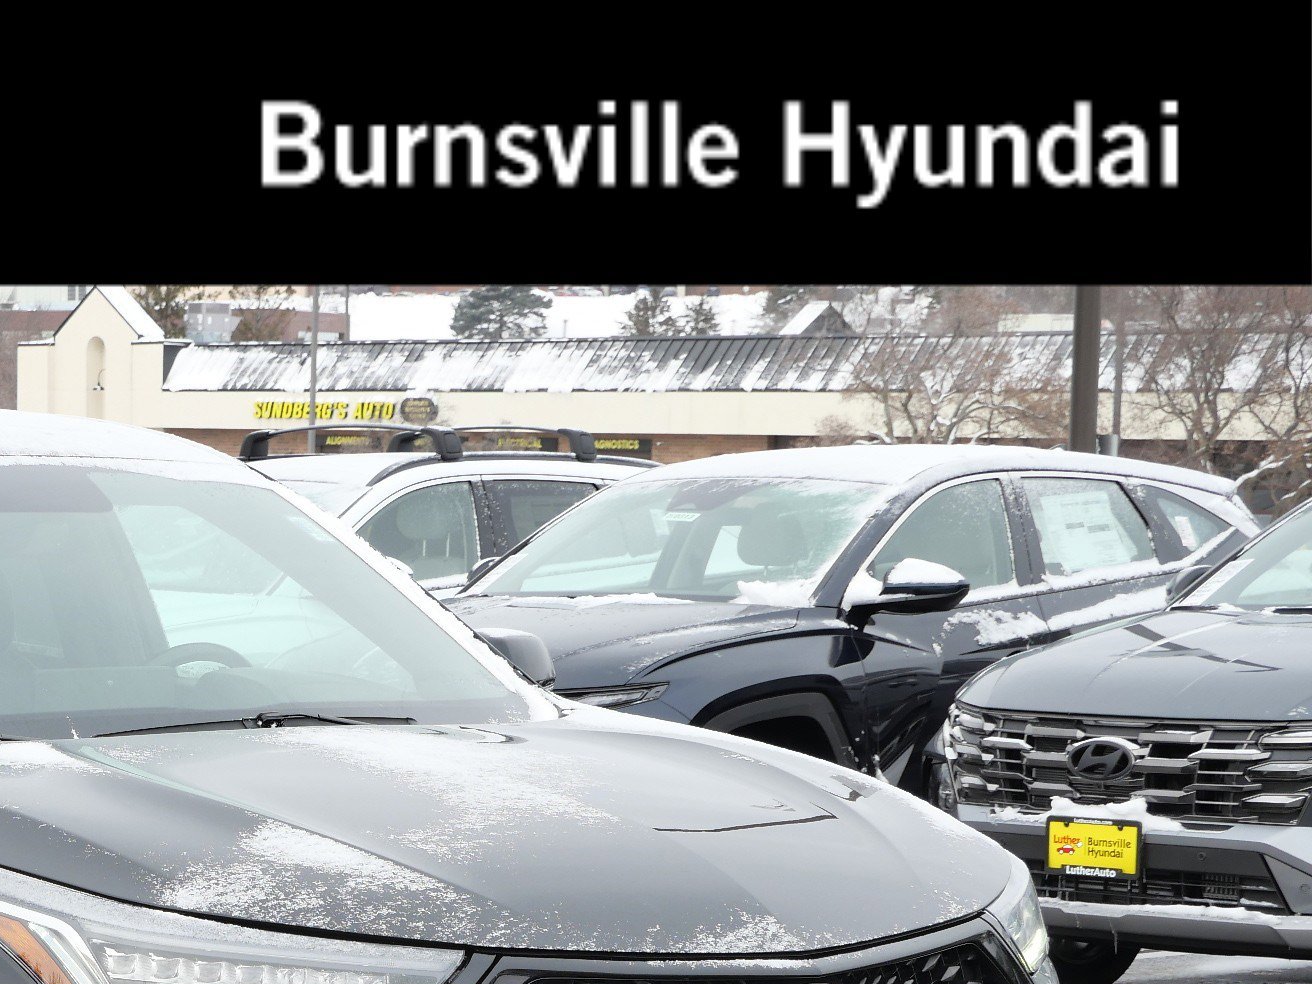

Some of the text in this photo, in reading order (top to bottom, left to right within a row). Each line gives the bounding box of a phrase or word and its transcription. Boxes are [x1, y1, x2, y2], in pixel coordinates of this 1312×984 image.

[253, 401, 349, 420] SUNDBERG'S
[353, 402, 395, 420] AUTO
[1053, 834, 1081, 845] Luther
[1087, 837, 1132, 849] Burnsville
[1087, 847, 1124, 859] Hyundai
[1065, 865, 1117, 878] LutherAuto
